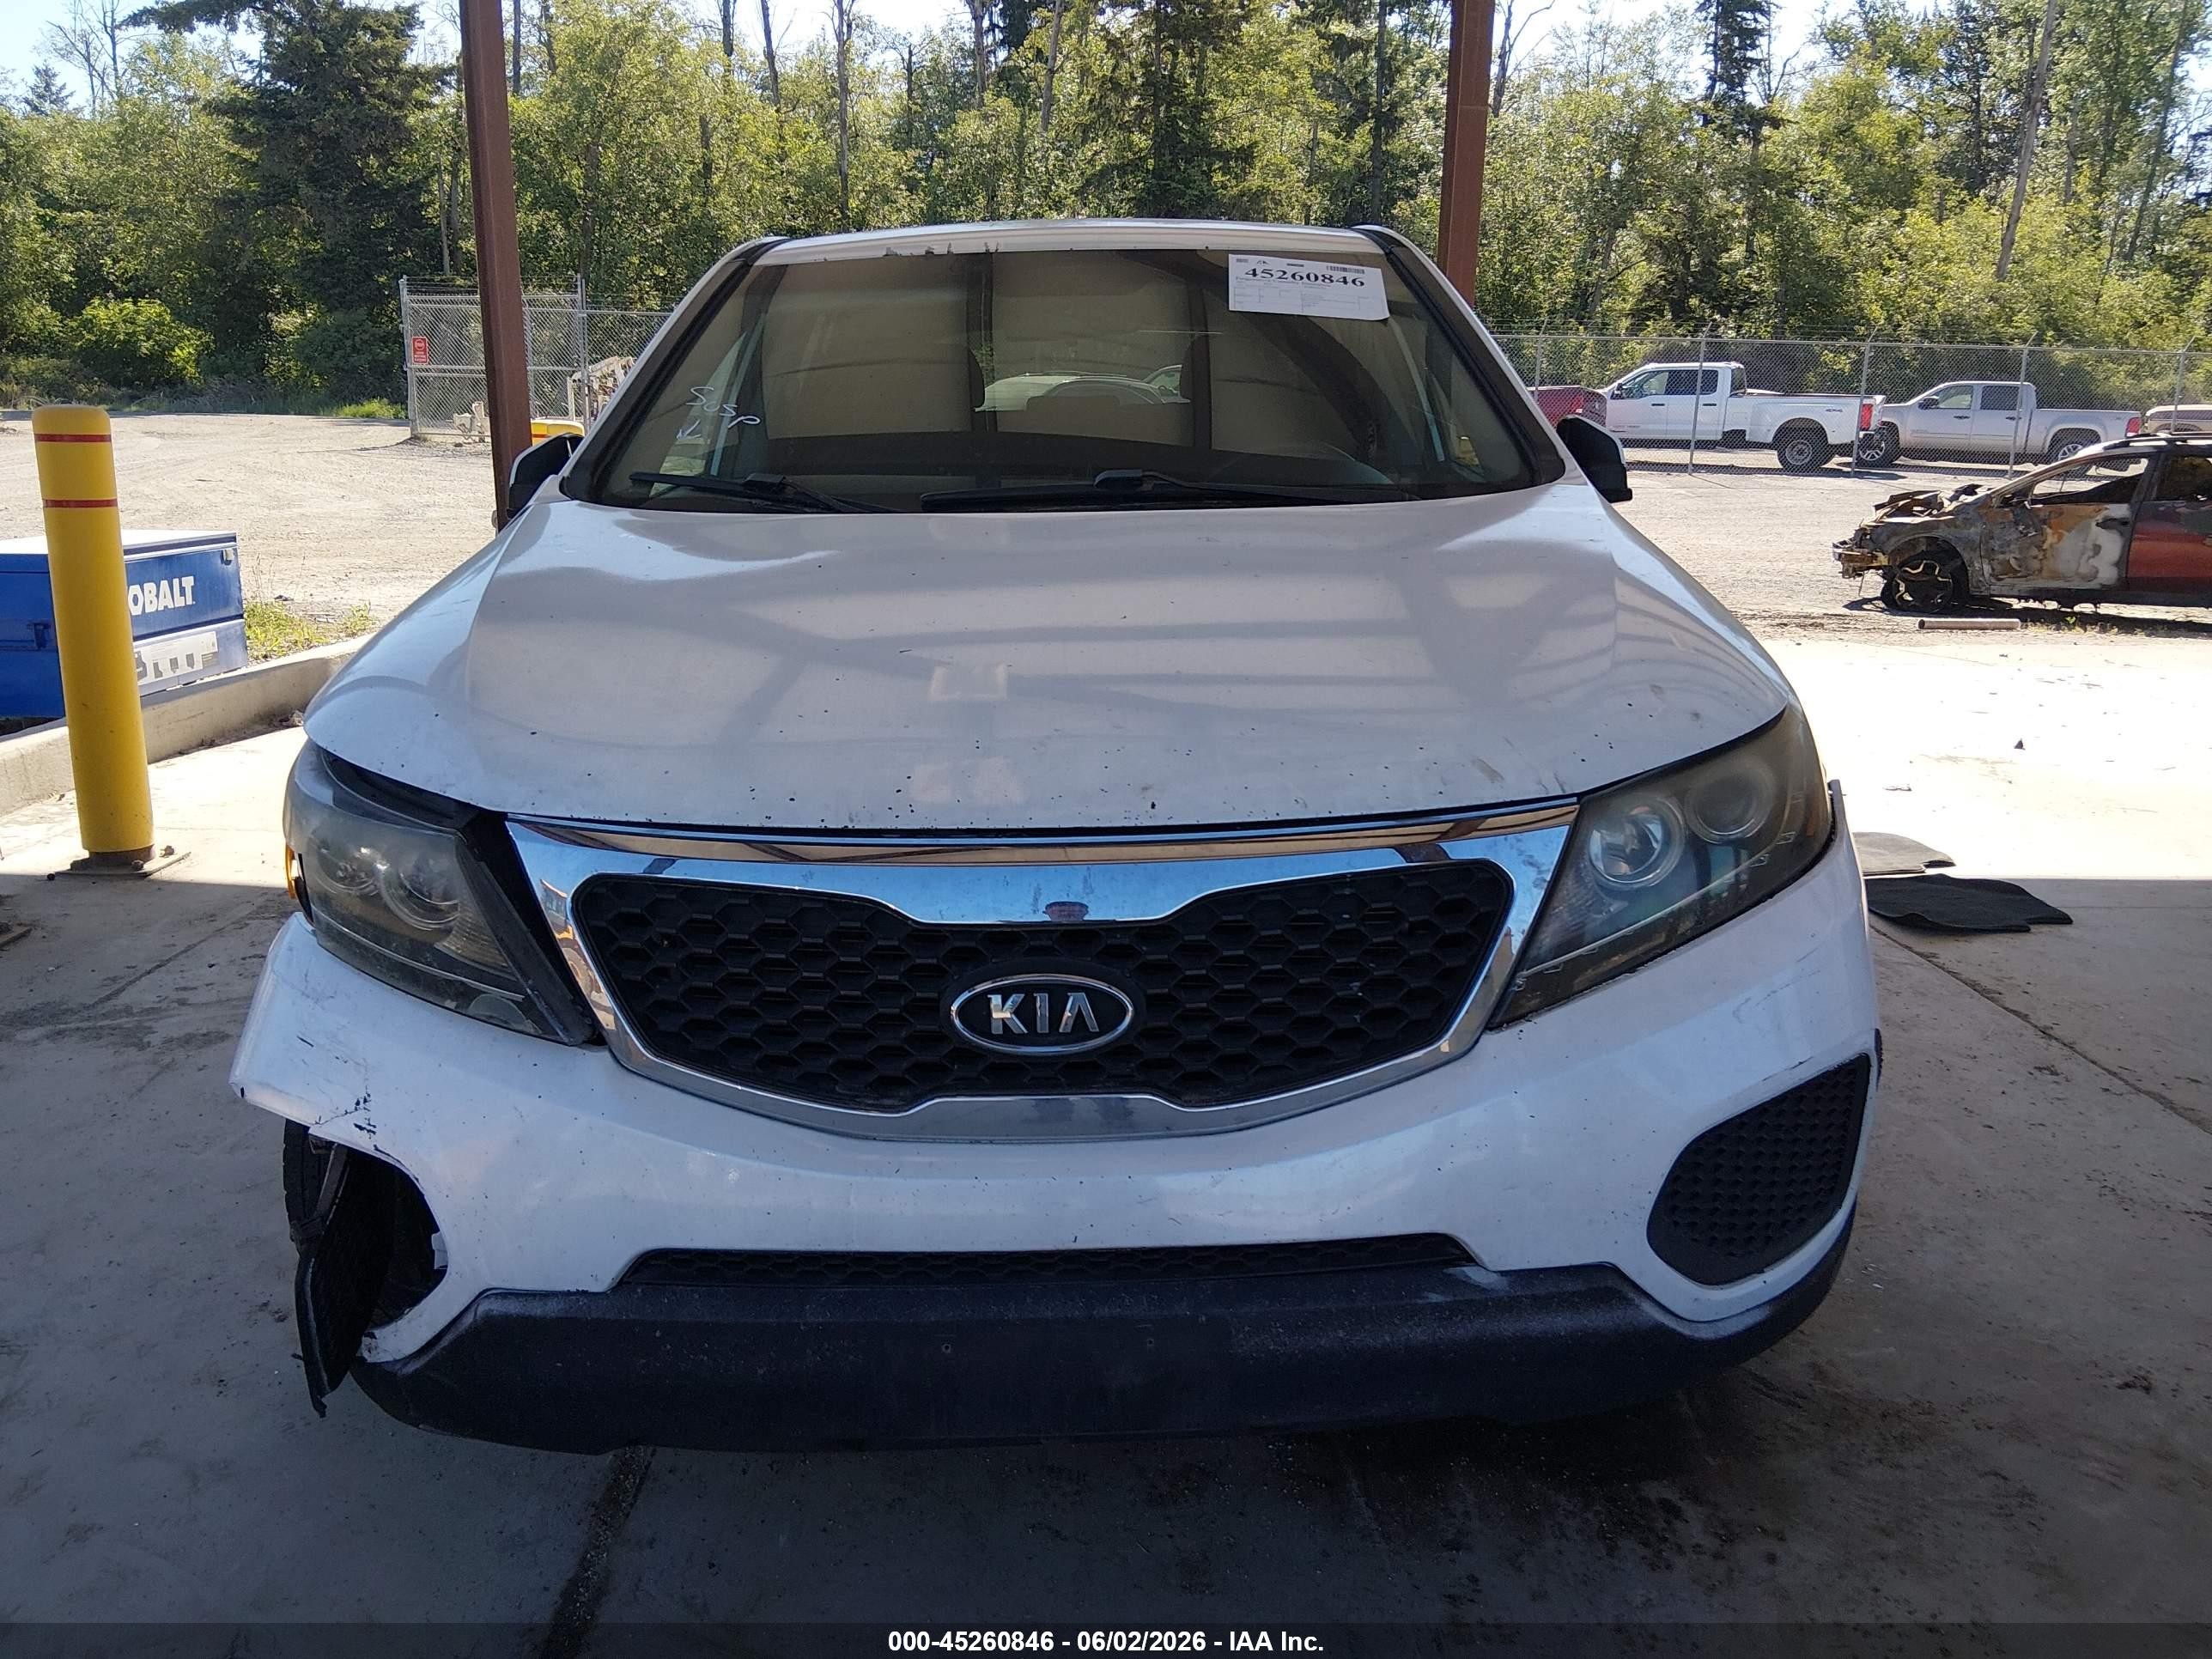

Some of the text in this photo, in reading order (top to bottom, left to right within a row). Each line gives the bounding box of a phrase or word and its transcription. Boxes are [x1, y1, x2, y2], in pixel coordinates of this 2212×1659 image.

[1245, 268, 1365, 287] 45260846
[128, 575, 195, 616] OBALT
[988, 992, 1100, 1035] KIA
